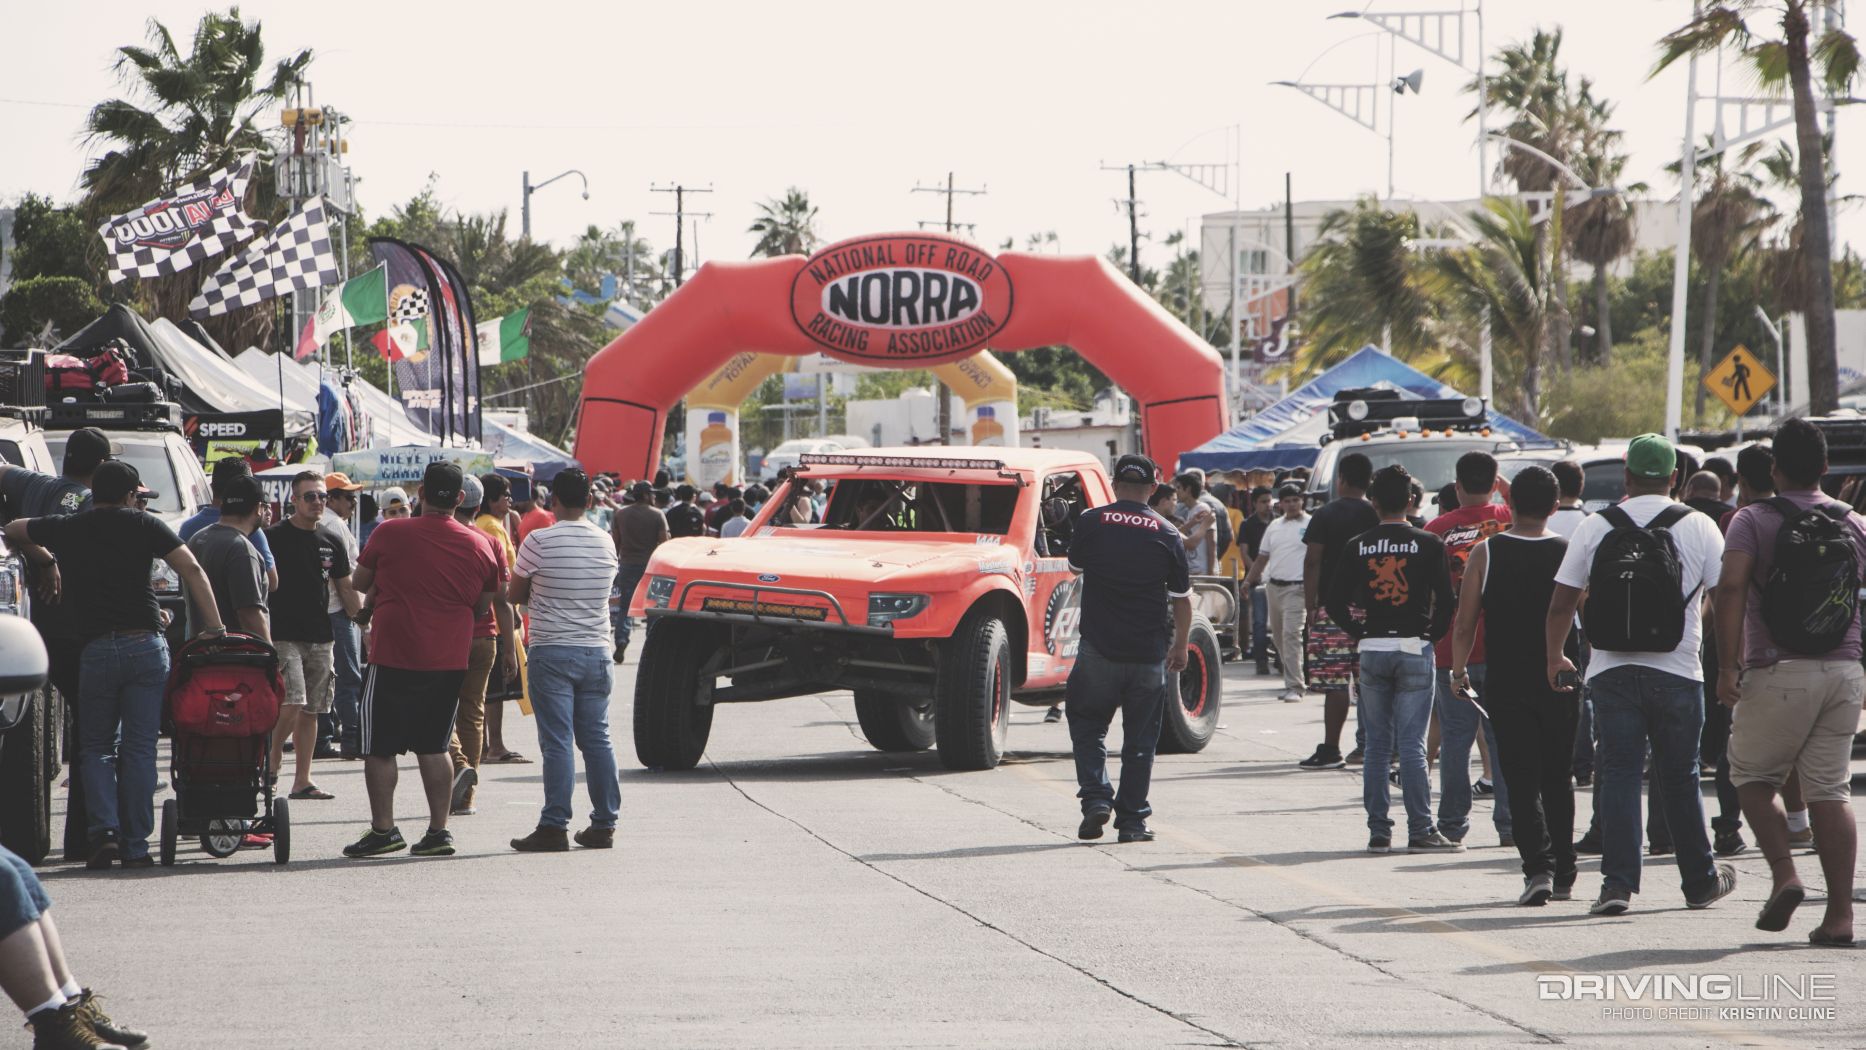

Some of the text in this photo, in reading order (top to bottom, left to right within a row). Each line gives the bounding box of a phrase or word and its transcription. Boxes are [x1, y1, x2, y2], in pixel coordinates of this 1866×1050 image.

[809, 243, 993, 285] NATIONAL OFF ROAD
[829, 270, 978, 326] NORRA
[808, 310, 995, 354] RACING ASSOCIATION
[200, 422, 246, 437] SPEED
[380, 453, 423, 465] NIEVE
[1104, 512, 1159, 530] TOYOTA
[1444, 529, 1479, 546] RPM
[1359, 538, 1418, 556] holland
